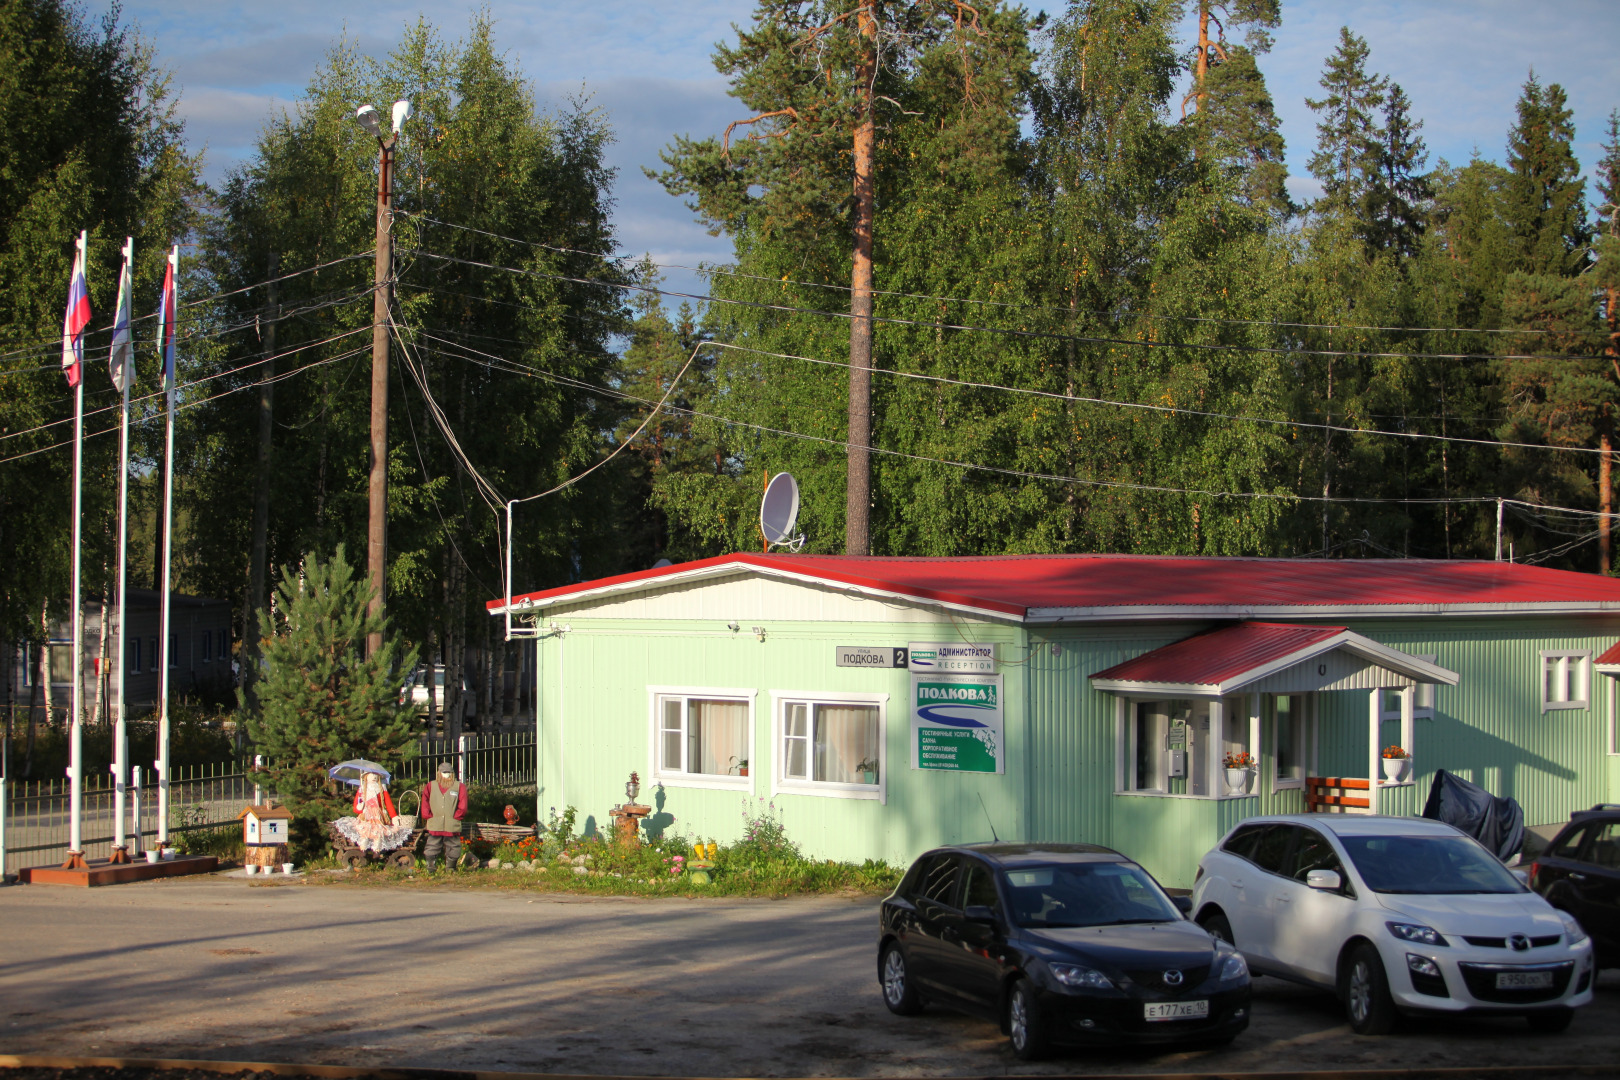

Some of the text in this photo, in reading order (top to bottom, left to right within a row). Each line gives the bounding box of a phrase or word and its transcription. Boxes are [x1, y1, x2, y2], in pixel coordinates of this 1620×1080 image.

[896, 650, 905, 664] 2
[938, 647, 992, 658] АДМИНИСТРАТОР
[843, 654, 885, 665] ПОДКОВА
[919, 687, 987, 701] ПОДКОВА
